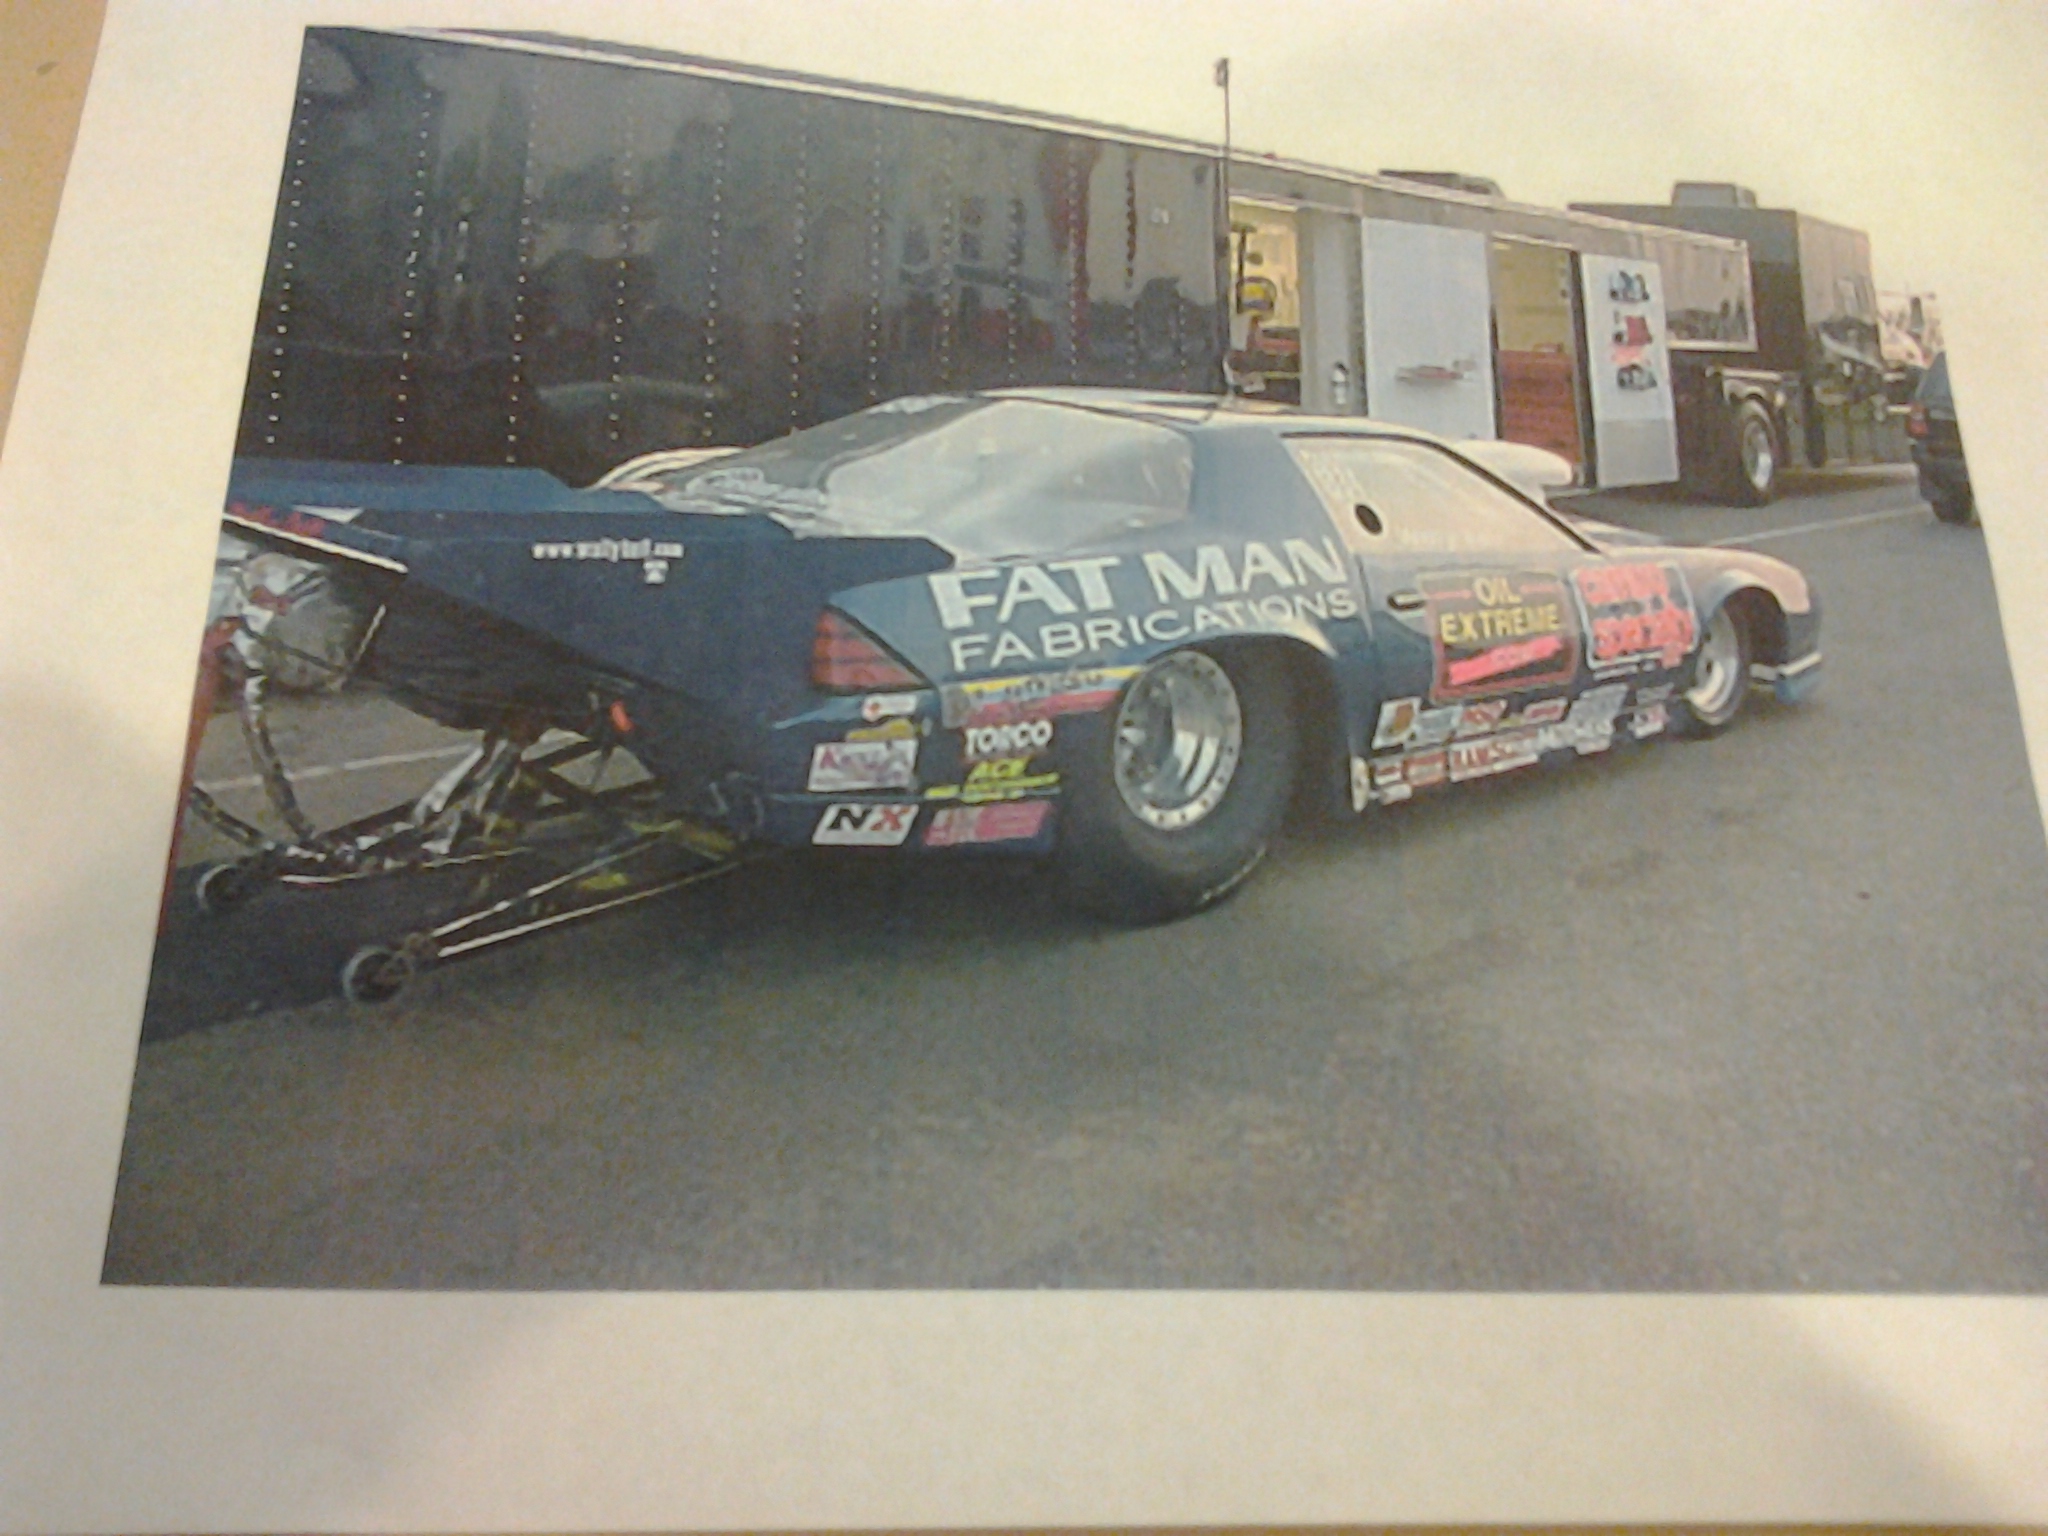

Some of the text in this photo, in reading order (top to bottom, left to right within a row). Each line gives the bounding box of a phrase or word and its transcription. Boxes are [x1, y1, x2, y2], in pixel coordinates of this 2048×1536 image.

[927, 535, 1348, 629] FAT MAN
[1473, 577, 1522, 606] OIL
[949, 588, 1359, 672] FABRICATIONS
[827, 807, 912, 831] NX
